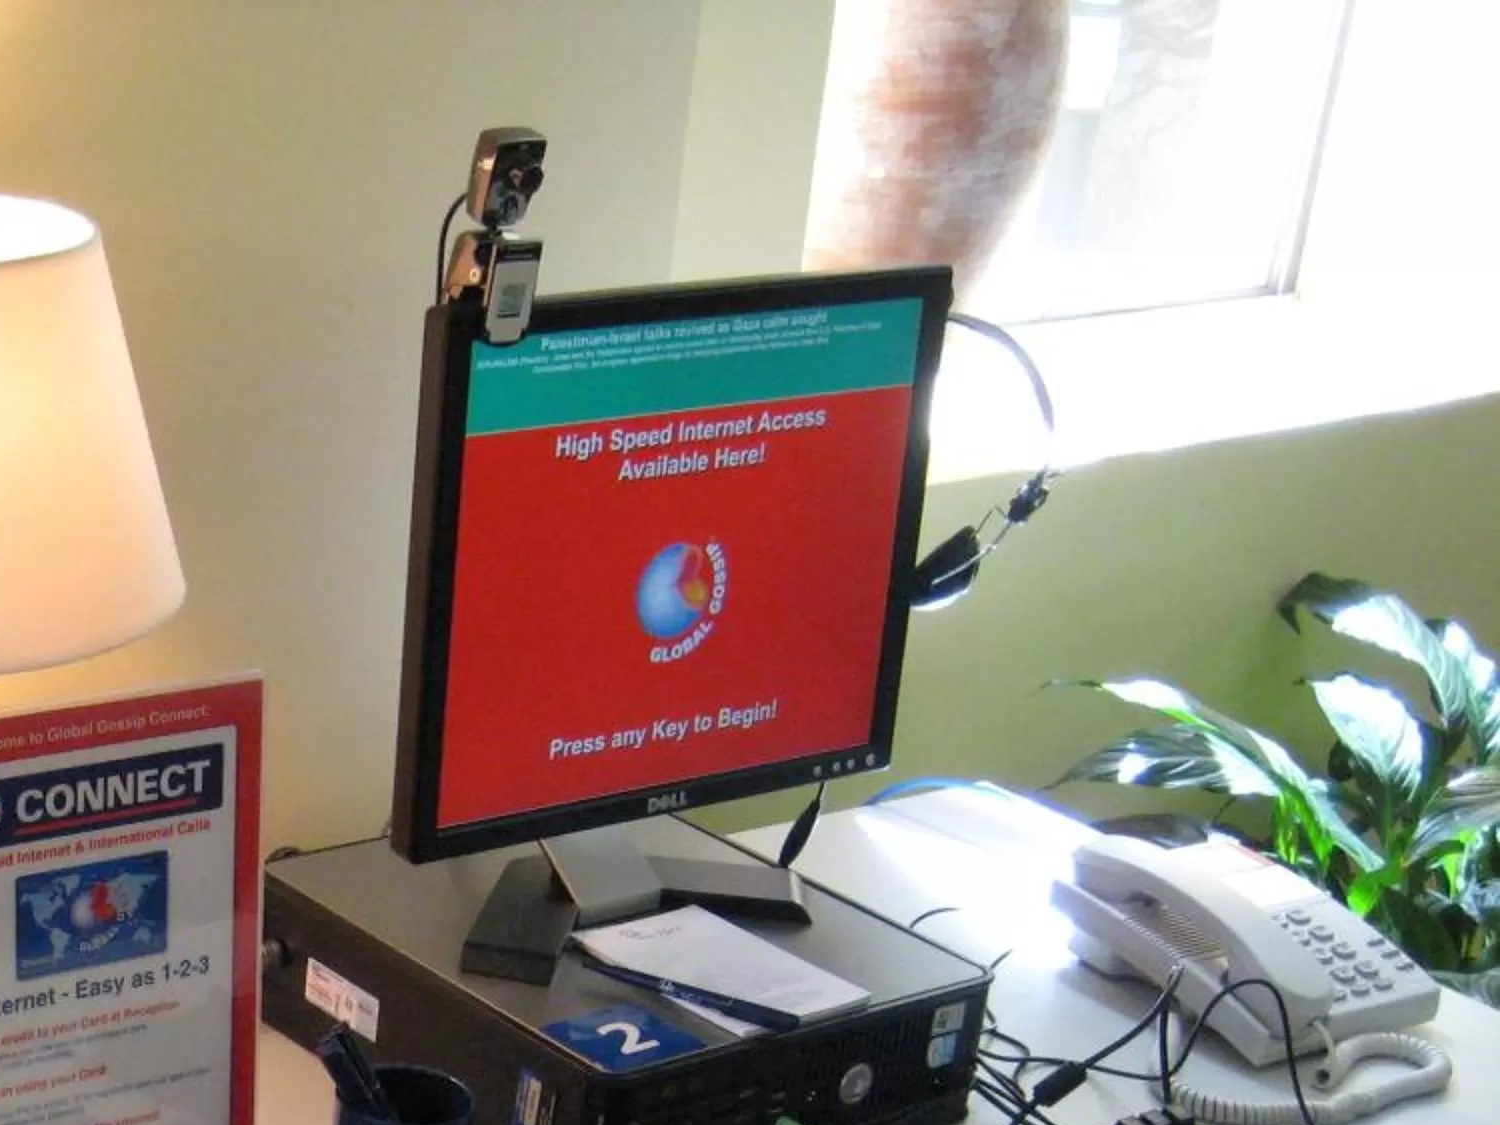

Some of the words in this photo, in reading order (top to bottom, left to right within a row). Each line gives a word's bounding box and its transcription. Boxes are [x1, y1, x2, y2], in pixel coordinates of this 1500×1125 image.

[555, 431, 603, 460] High
[610, 422, 672, 455] Speed
[679, 415, 753, 442] Internet
[758, 407, 827, 432] Access
[618, 447, 710, 482] Available
[714, 443, 765, 469] Here!
[705, 542, 728, 615] GOSSIP
[649, 620, 714, 664] GLOBAL
[30, 733, 44, 746] to
[47, 723, 93, 743] Global
[97, 714, 147, 735] Gossip
[549, 733, 606, 760] Press
[611, 727, 645, 750] any
[651, 718, 688, 742] Key
[693, 714, 712, 732] to
[718, 699, 778, 730] Begin!
[15, 759, 212, 824] CONNECT
[17, 844, 71, 866] Internet
[88, 826, 175, 851] International
[177, 815, 212, 835] Calls
[76, 978, 125, 1002] Easy
[131, 971, 156, 989] as
[163, 954, 211, 981] 1-2-3
[596, 1022, 660, 1057] 2
